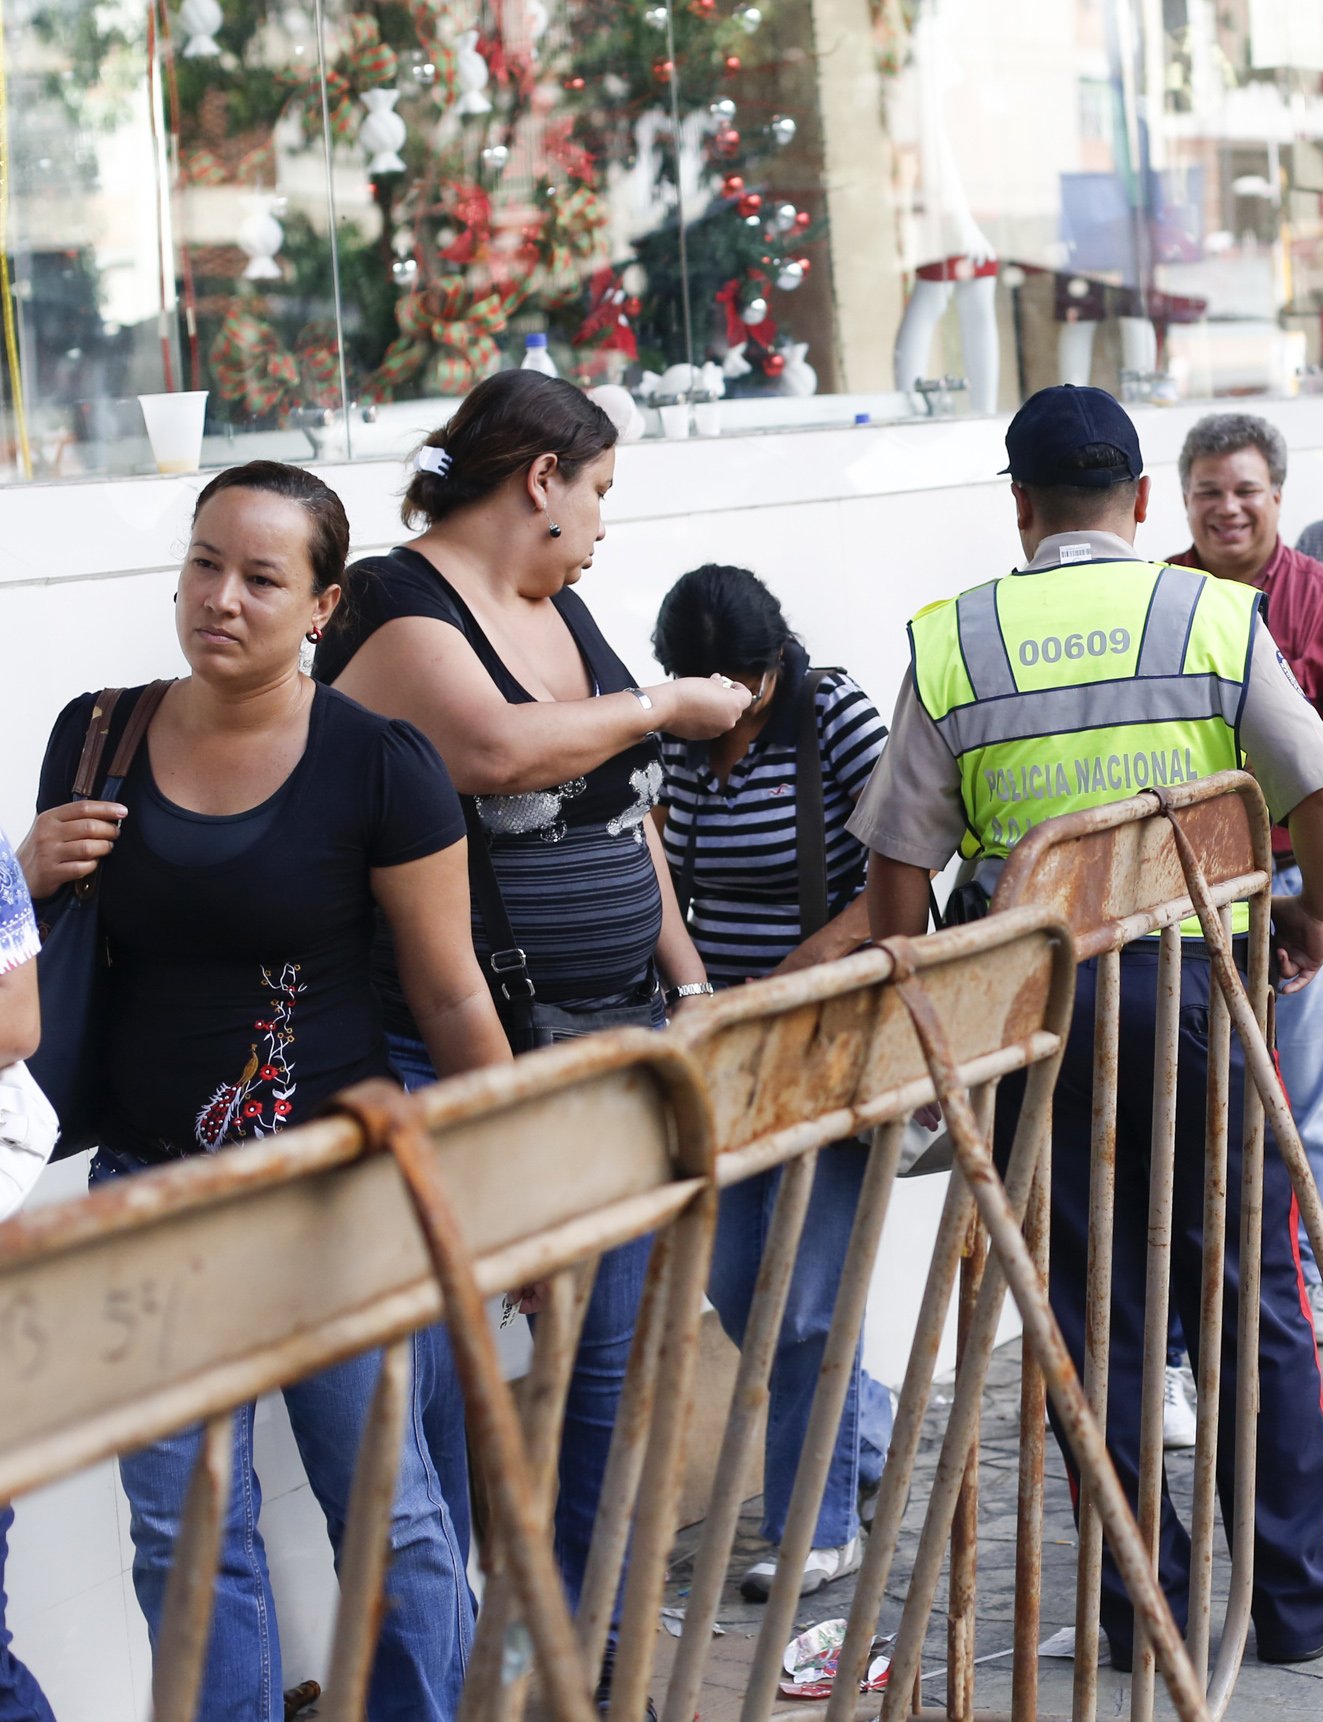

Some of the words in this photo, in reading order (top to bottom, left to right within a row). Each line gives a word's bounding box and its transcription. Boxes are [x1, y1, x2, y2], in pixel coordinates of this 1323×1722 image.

[1019, 628, 1131, 667] 00609
[983, 762, 1072, 803] POLICIA
[1073, 747, 1198, 795] NACIONAL
